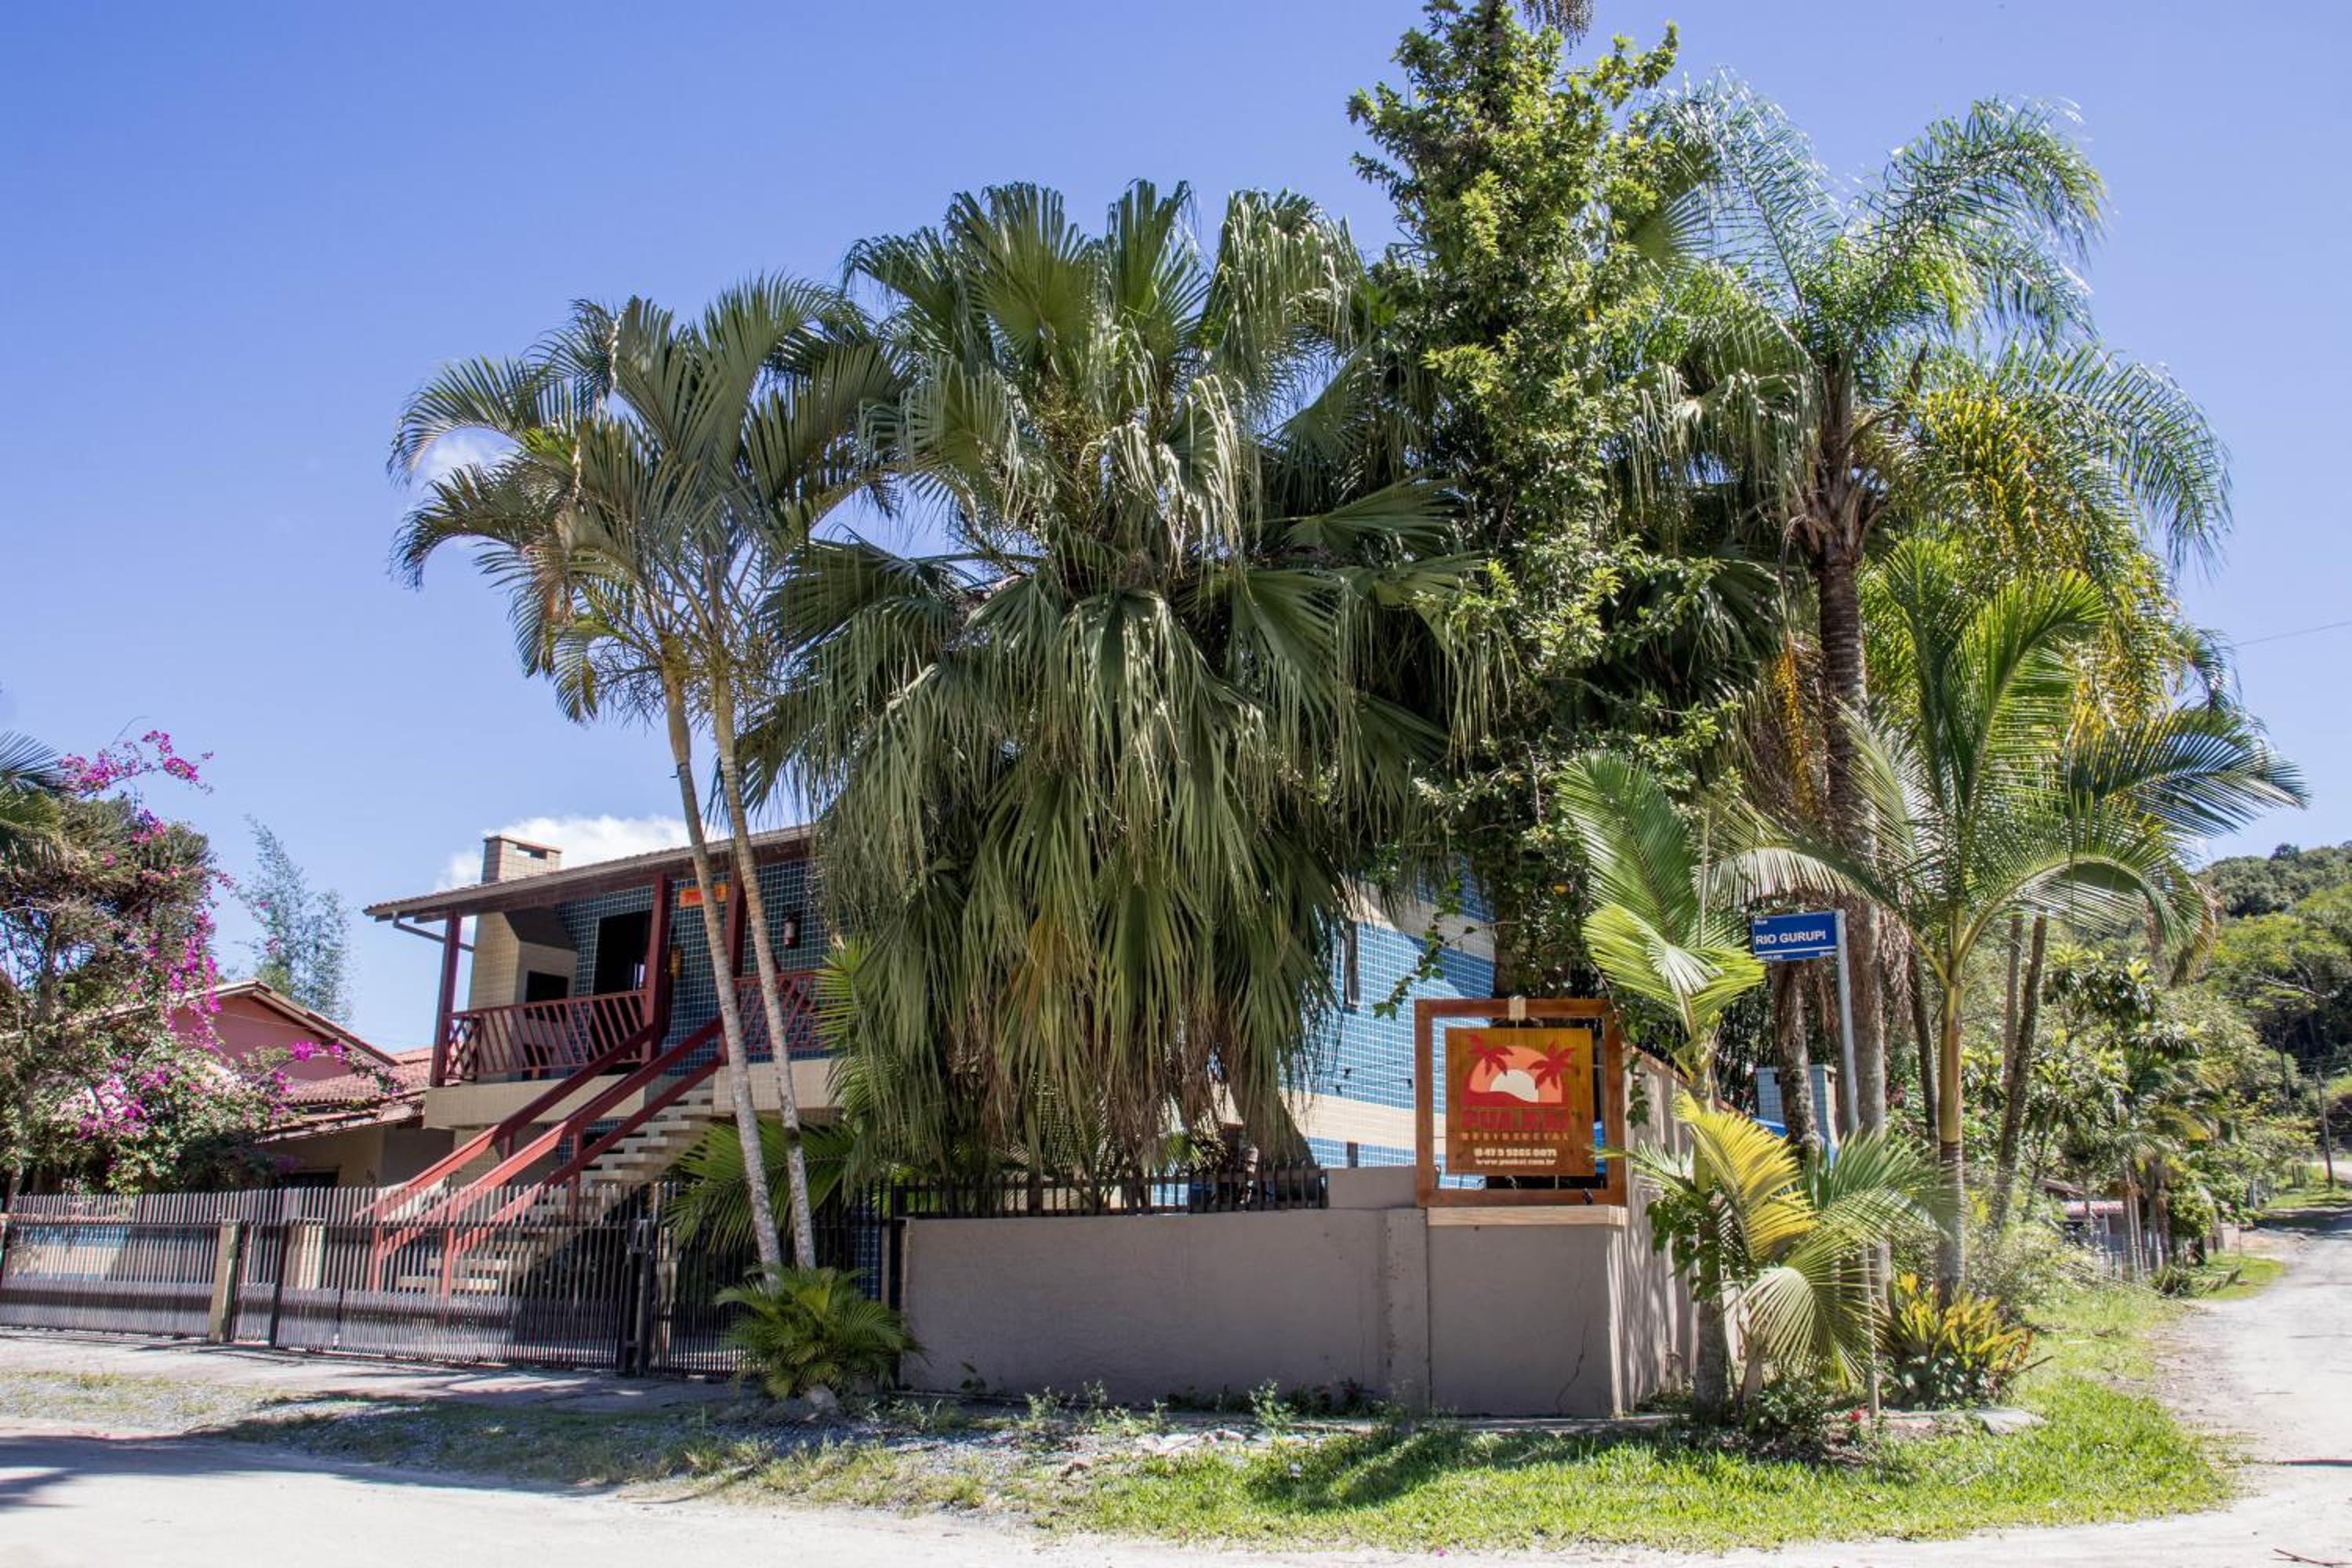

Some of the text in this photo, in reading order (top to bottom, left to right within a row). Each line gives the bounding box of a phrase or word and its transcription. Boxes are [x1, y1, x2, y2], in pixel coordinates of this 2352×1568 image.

[1755, 930, 1826, 945] RIO GURUPI
[1461, 1132, 1569, 1141] RESIDENCIAL
